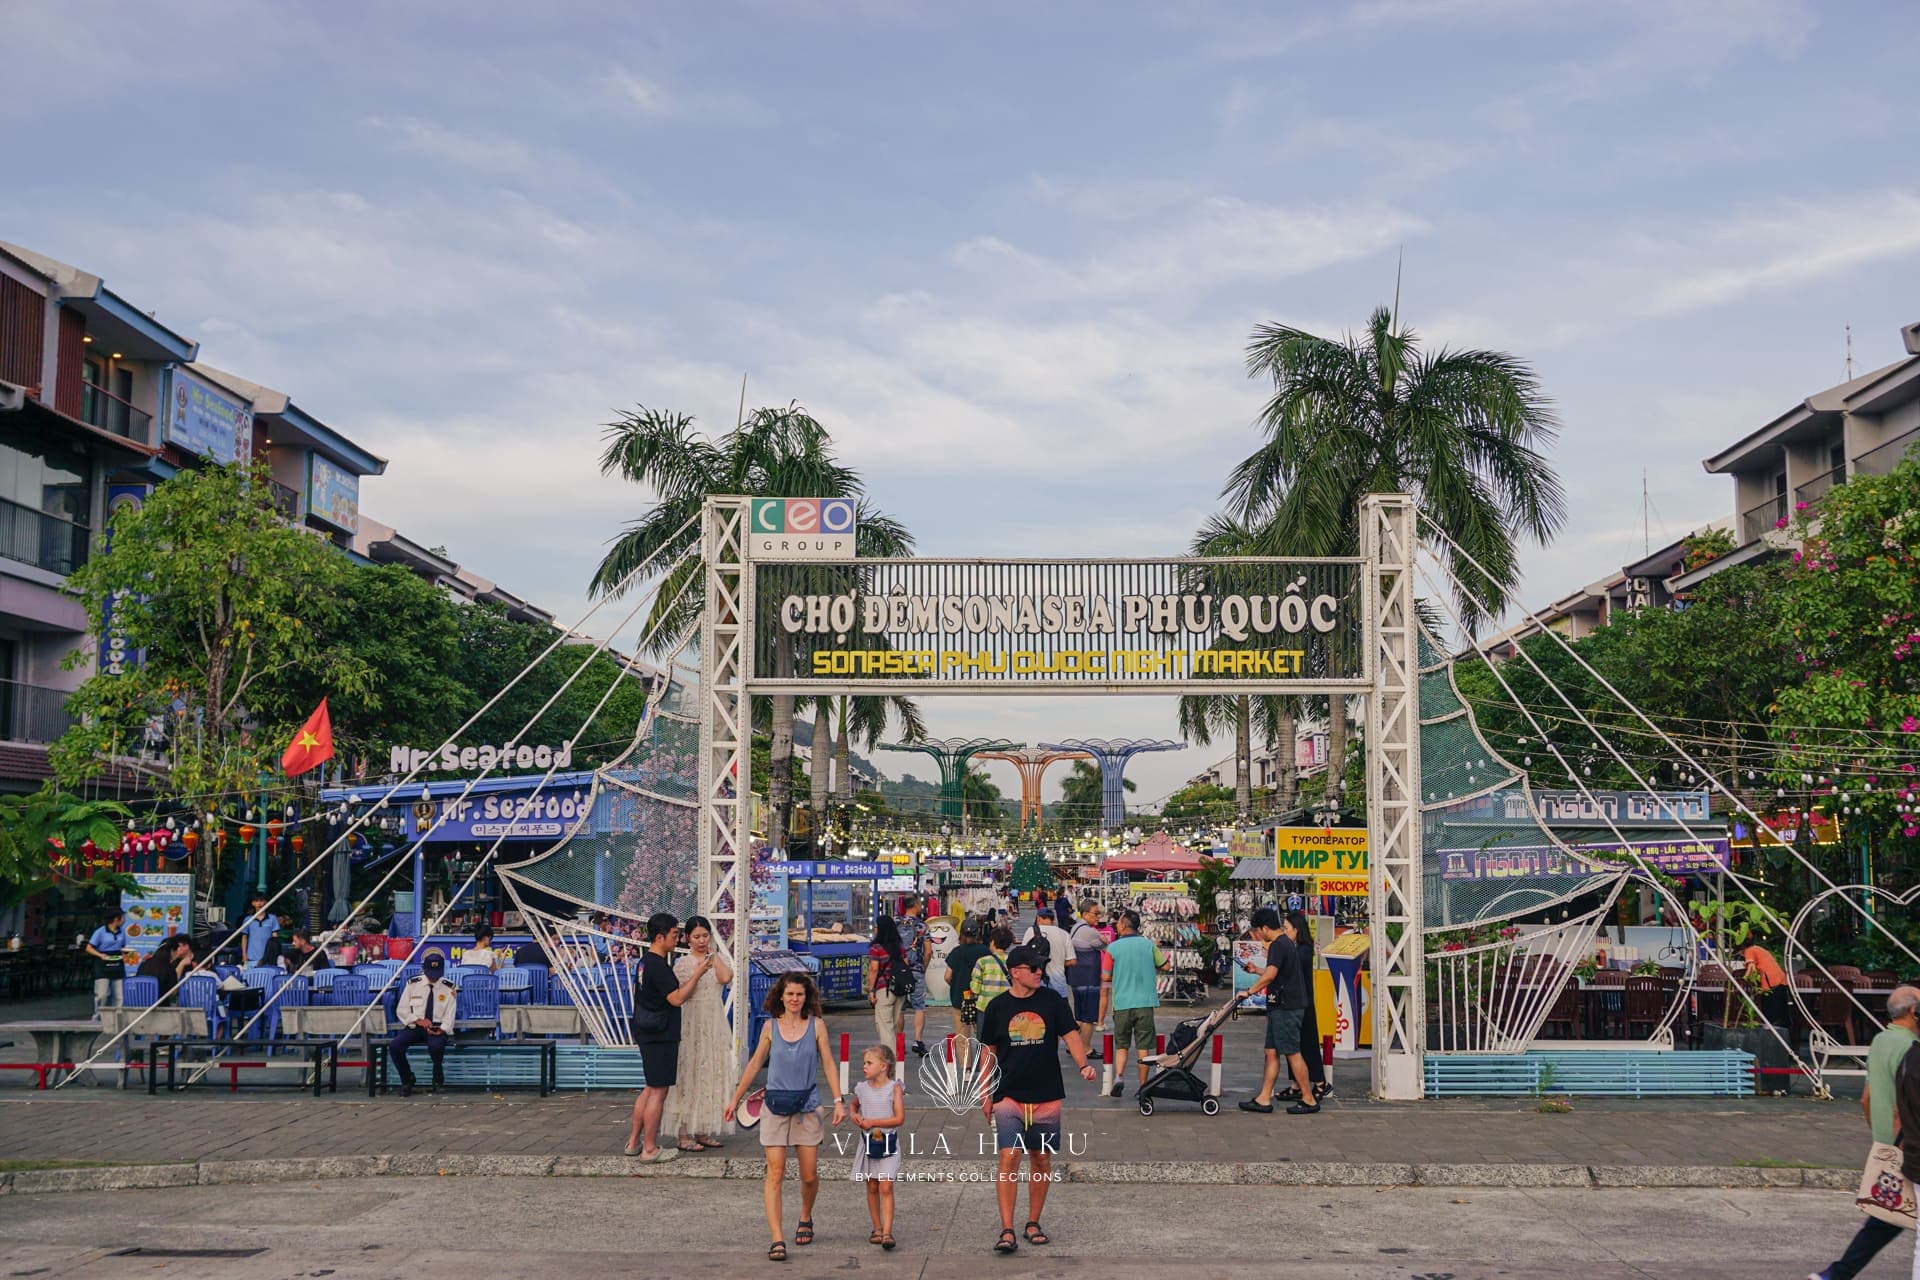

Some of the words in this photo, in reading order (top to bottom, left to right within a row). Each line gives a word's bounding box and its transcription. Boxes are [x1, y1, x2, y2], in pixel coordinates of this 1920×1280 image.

[763, 541, 842, 551] GROUP
[781, 588, 856, 645] CHỢ
[862, 583, 939, 634] ĐÊM
[942, 594, 1116, 634] SONASEA
[1122, 582, 1213, 634] PHÚ
[1220, 575, 1337, 643] QUỐC
[813, 650, 935, 674] SONASEA
[942, 651, 1008, 673] PHU
[1014, 650, 1106, 674] QUOC
[1111, 650, 1187, 673] NIGHT
[1193, 650, 1305, 674] MARKET
[1292, 835, 1366, 845] ТУРОПЕРАТОР
[1280, 850, 1329, 869] МИР
